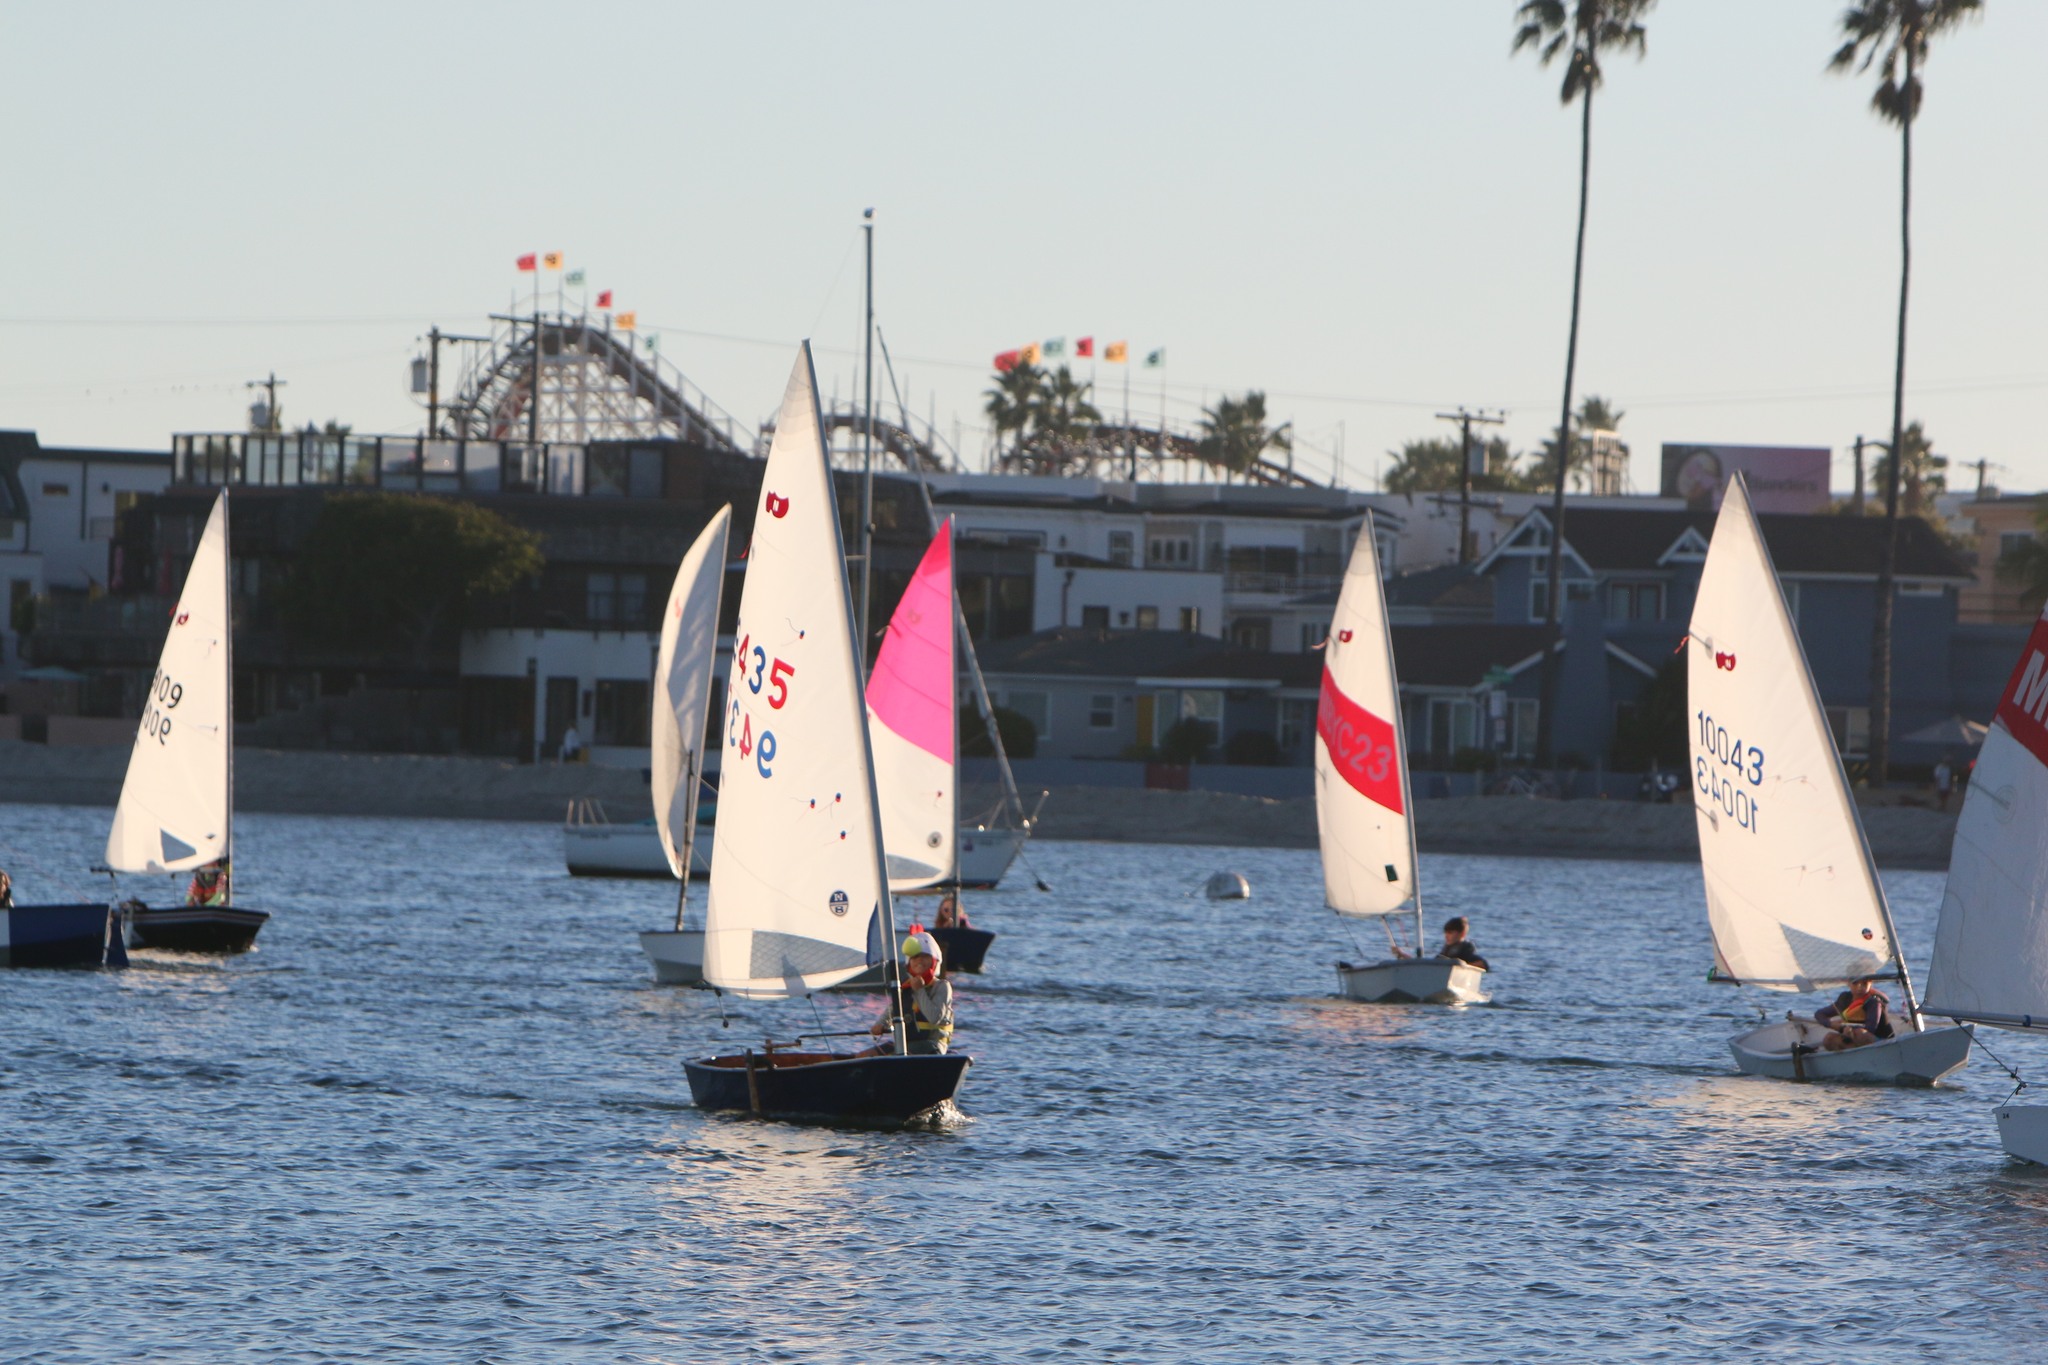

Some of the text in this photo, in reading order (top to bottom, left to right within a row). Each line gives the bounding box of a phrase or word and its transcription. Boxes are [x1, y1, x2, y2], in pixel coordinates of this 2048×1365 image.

[733, 617, 795, 709] 435
[2012, 648, 2048, 731] M
[1697, 710, 1764, 786] 10043
